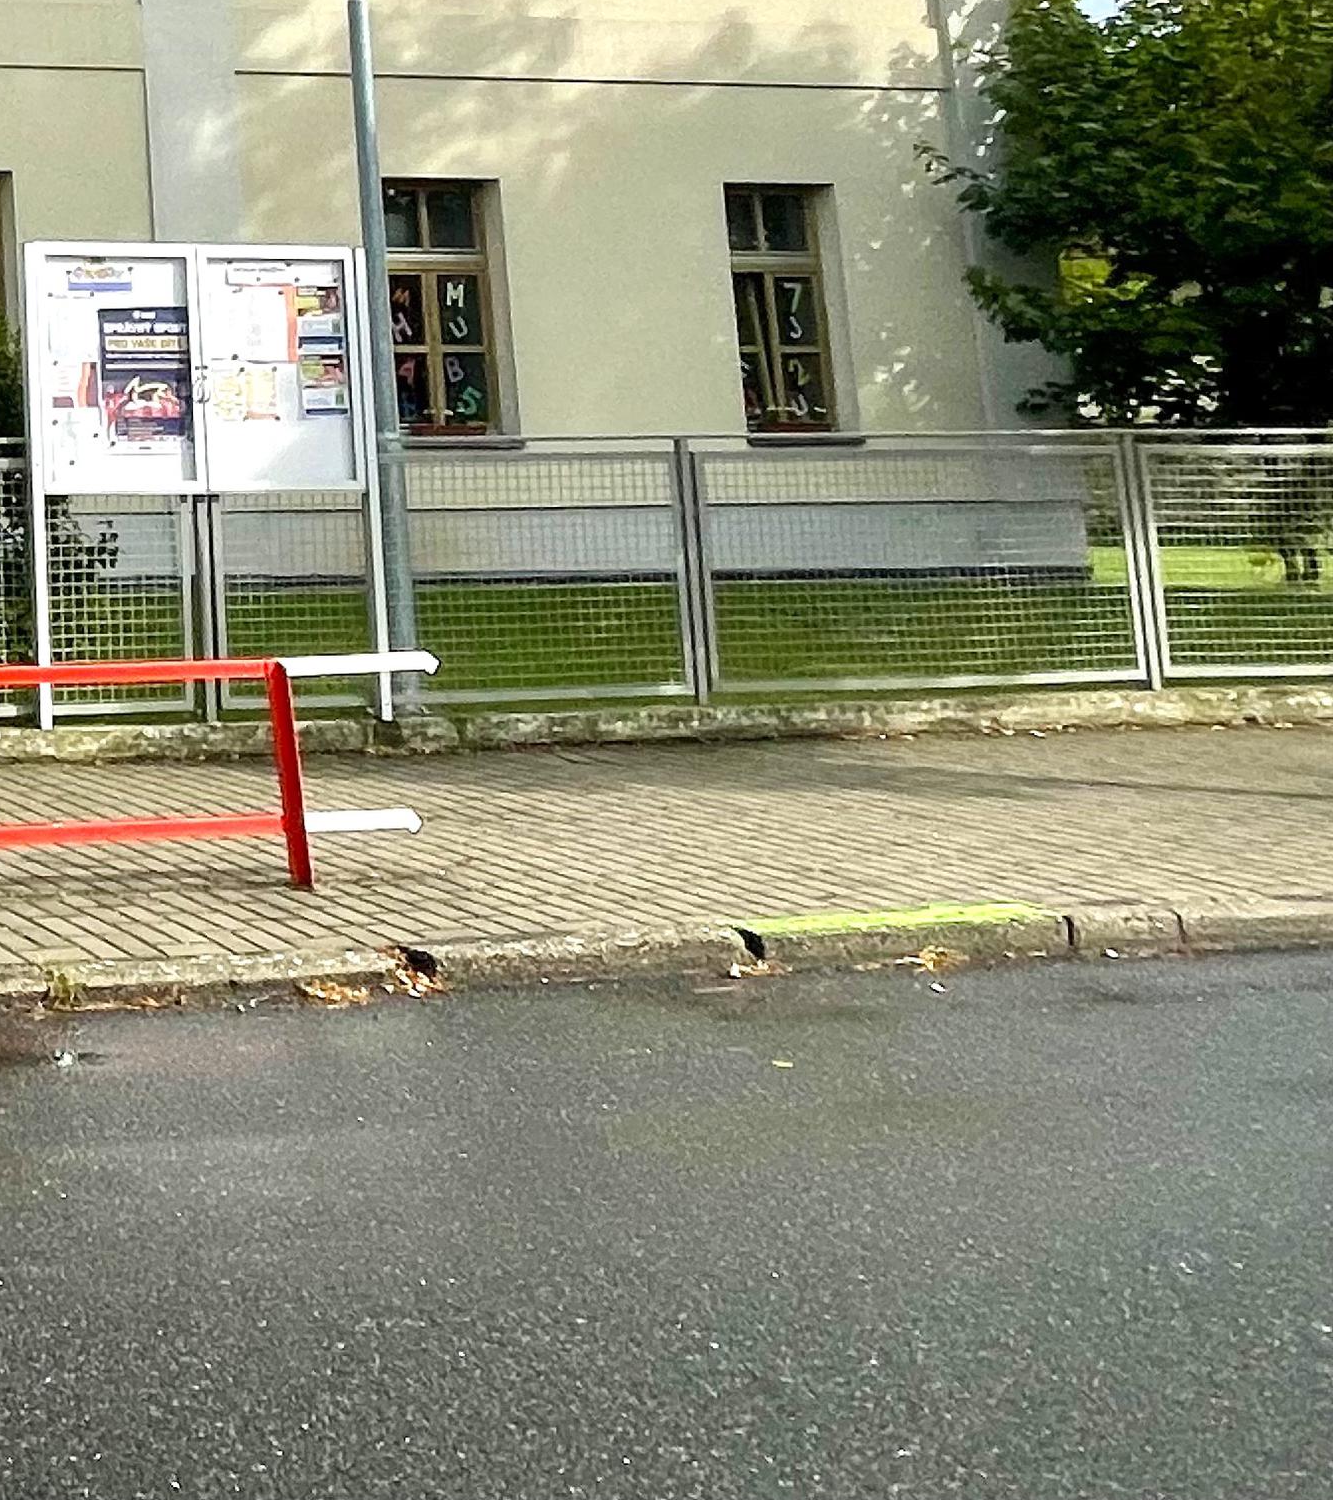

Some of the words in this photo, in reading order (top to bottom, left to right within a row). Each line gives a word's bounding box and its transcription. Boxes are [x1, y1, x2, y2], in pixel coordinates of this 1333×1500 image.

[446, 282, 464, 308] M
[783, 282, 802, 314] 7
[445, 356, 464, 383] B
